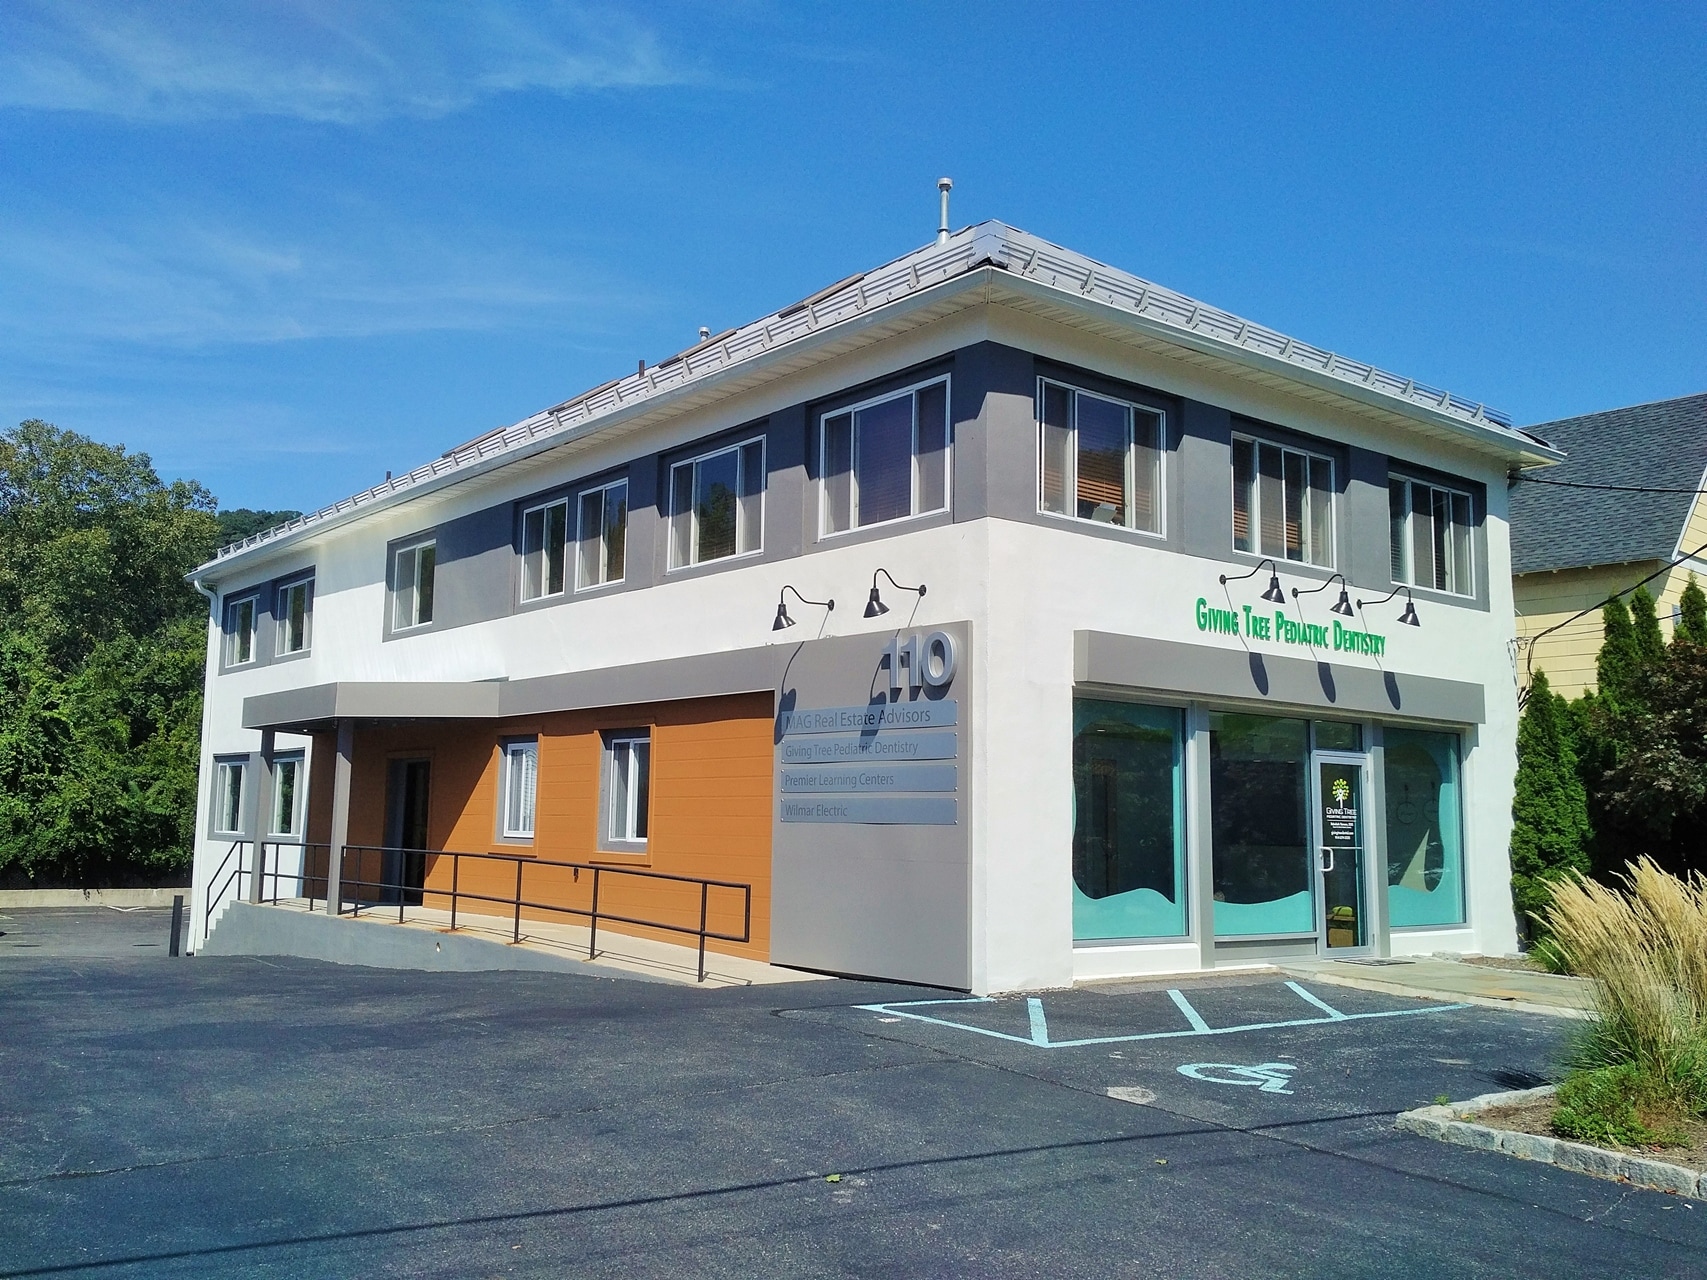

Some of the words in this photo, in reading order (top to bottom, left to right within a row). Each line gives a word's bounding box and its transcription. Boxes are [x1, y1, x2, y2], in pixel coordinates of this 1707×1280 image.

[1195, 597, 1239, 636] GIVING
[1242, 604, 1271, 641] TREE
[1275, 610, 1329, 650] PEDIATRIC
[1332, 619, 1386, 657] DENTISTRY
[881, 631, 957, 690] 110
[786, 714, 812, 730] MAG
[814, 713, 838, 728] Real
[840, 711, 875, 727] Estate
[877, 708, 931, 725] Advisors
[785, 745, 812, 760] Giving
[814, 744, 832, 756] Tree
[834, 742, 873, 756] Pediatric
[875, 741, 918, 757] Dentistry
[785, 774, 817, 787] Premier
[818, 773, 857, 788] Learning
[859, 772, 894, 785] Centers
[785, 805, 814, 817] Wilmar
[816, 805, 848, 818] Electric
